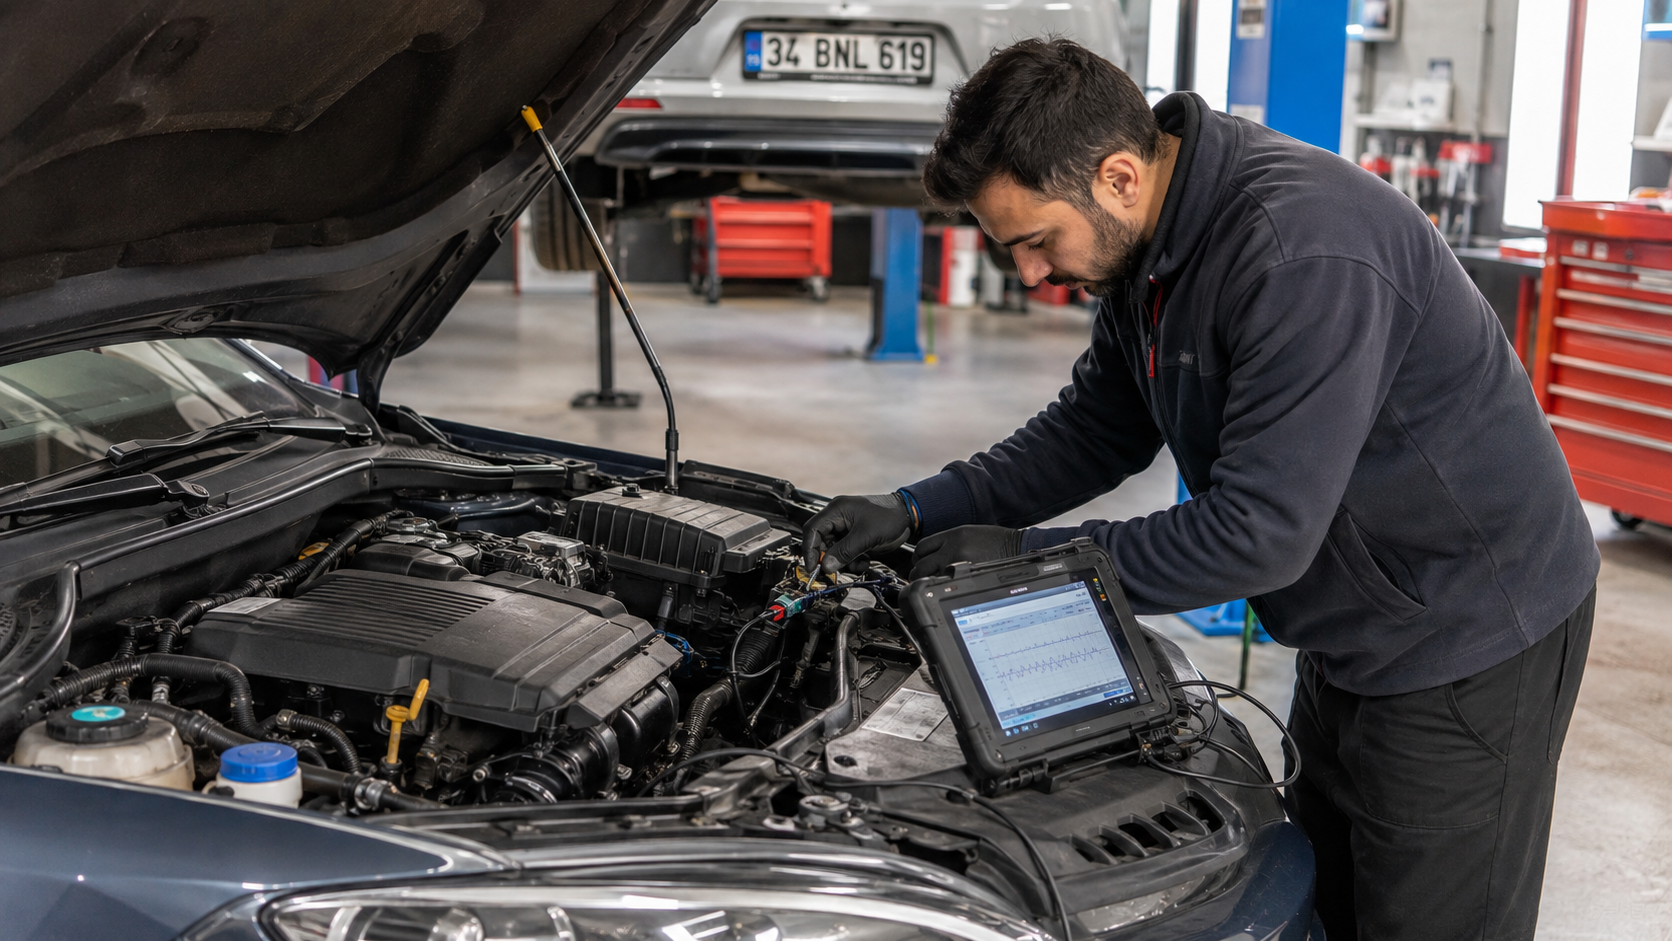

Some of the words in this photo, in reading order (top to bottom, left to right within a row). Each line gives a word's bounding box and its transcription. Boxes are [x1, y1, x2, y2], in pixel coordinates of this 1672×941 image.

[767, 37, 800, 67] 34
[816, 38, 868, 69] BNL
[879, 40, 926, 71] 619
